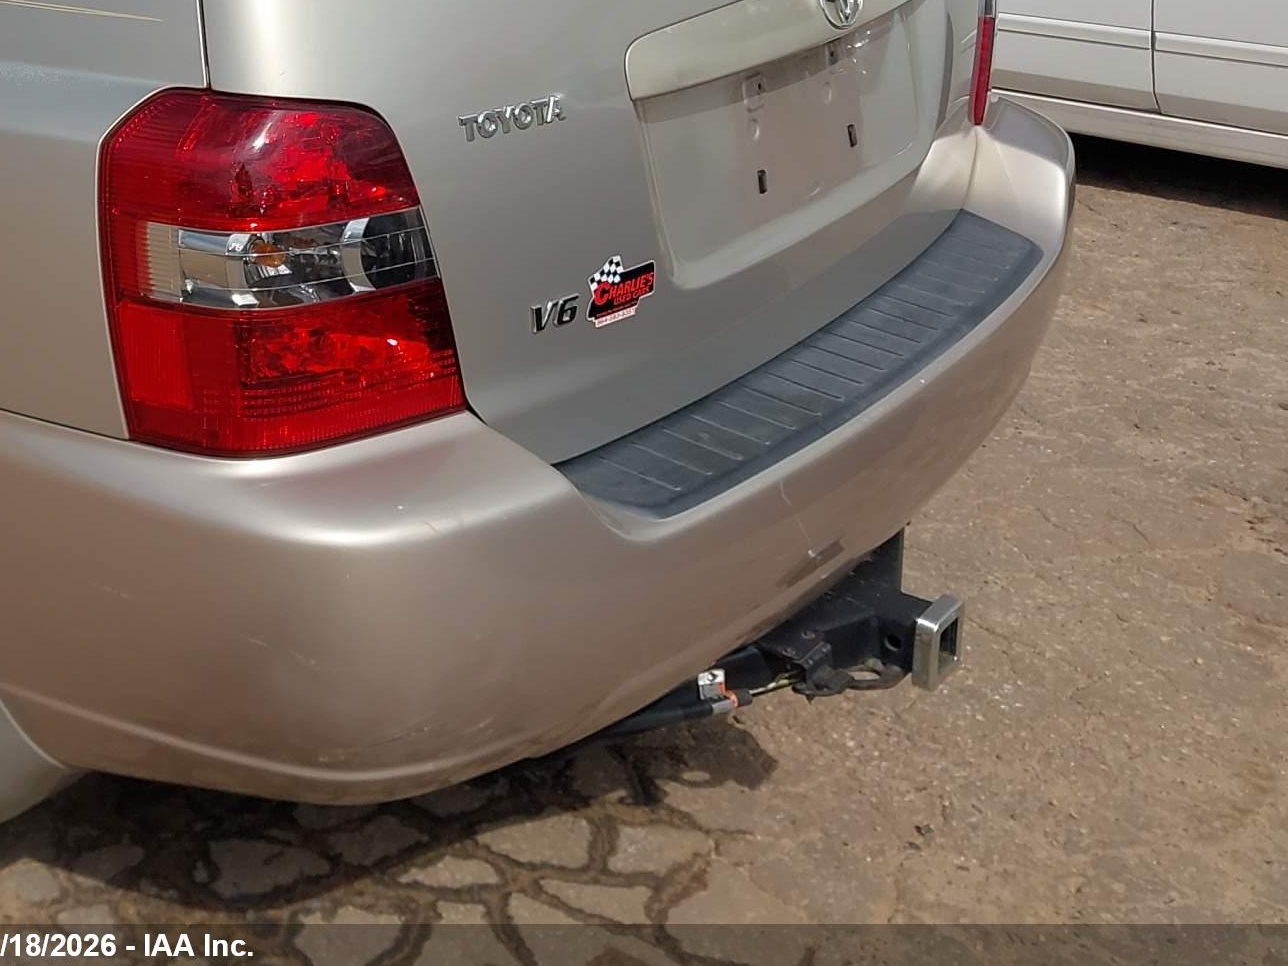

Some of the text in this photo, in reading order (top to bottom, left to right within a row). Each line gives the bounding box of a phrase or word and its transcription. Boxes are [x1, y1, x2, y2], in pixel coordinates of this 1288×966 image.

[457, 95, 567, 143] TOYOTA
[595, 272, 654, 305] CHARLIE'S
[530, 293, 580, 335] V6
